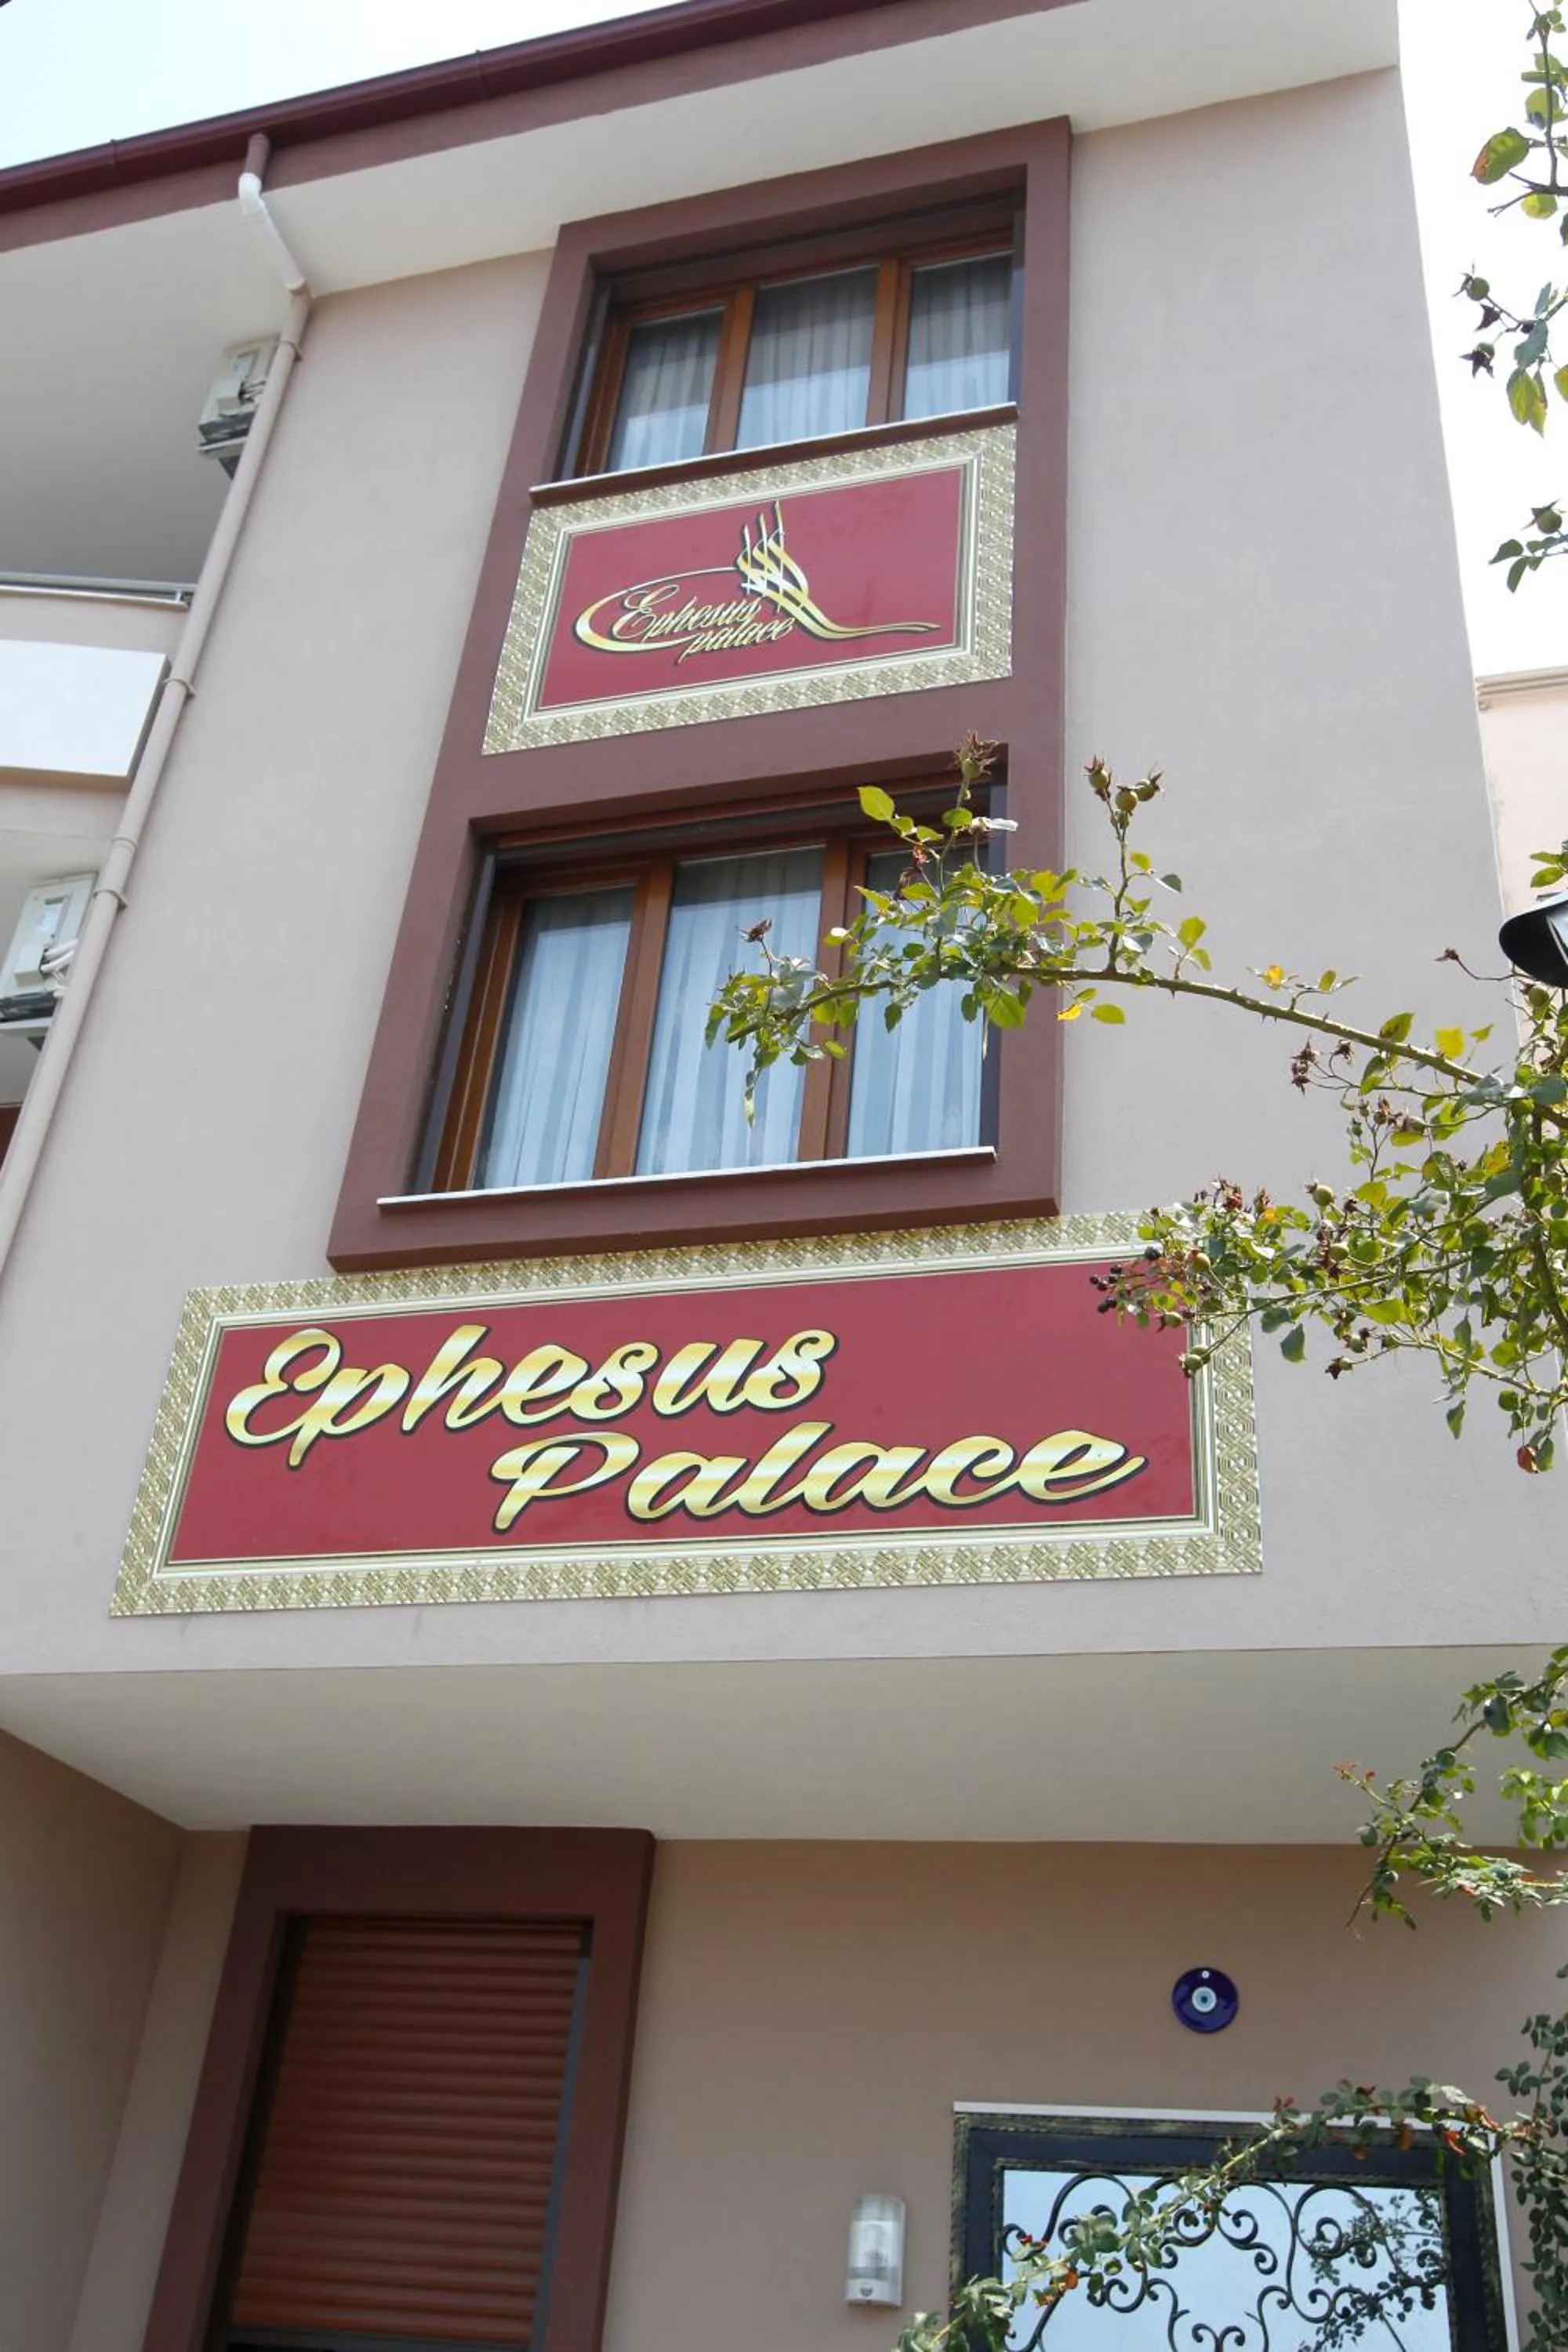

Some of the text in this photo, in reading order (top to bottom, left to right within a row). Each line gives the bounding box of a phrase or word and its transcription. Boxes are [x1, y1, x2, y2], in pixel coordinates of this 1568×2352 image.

[612, 584, 761, 644] Ephesus
[224, 1324, 837, 1468] Ephesus
[489, 1421, 1145, 1532] Palace
